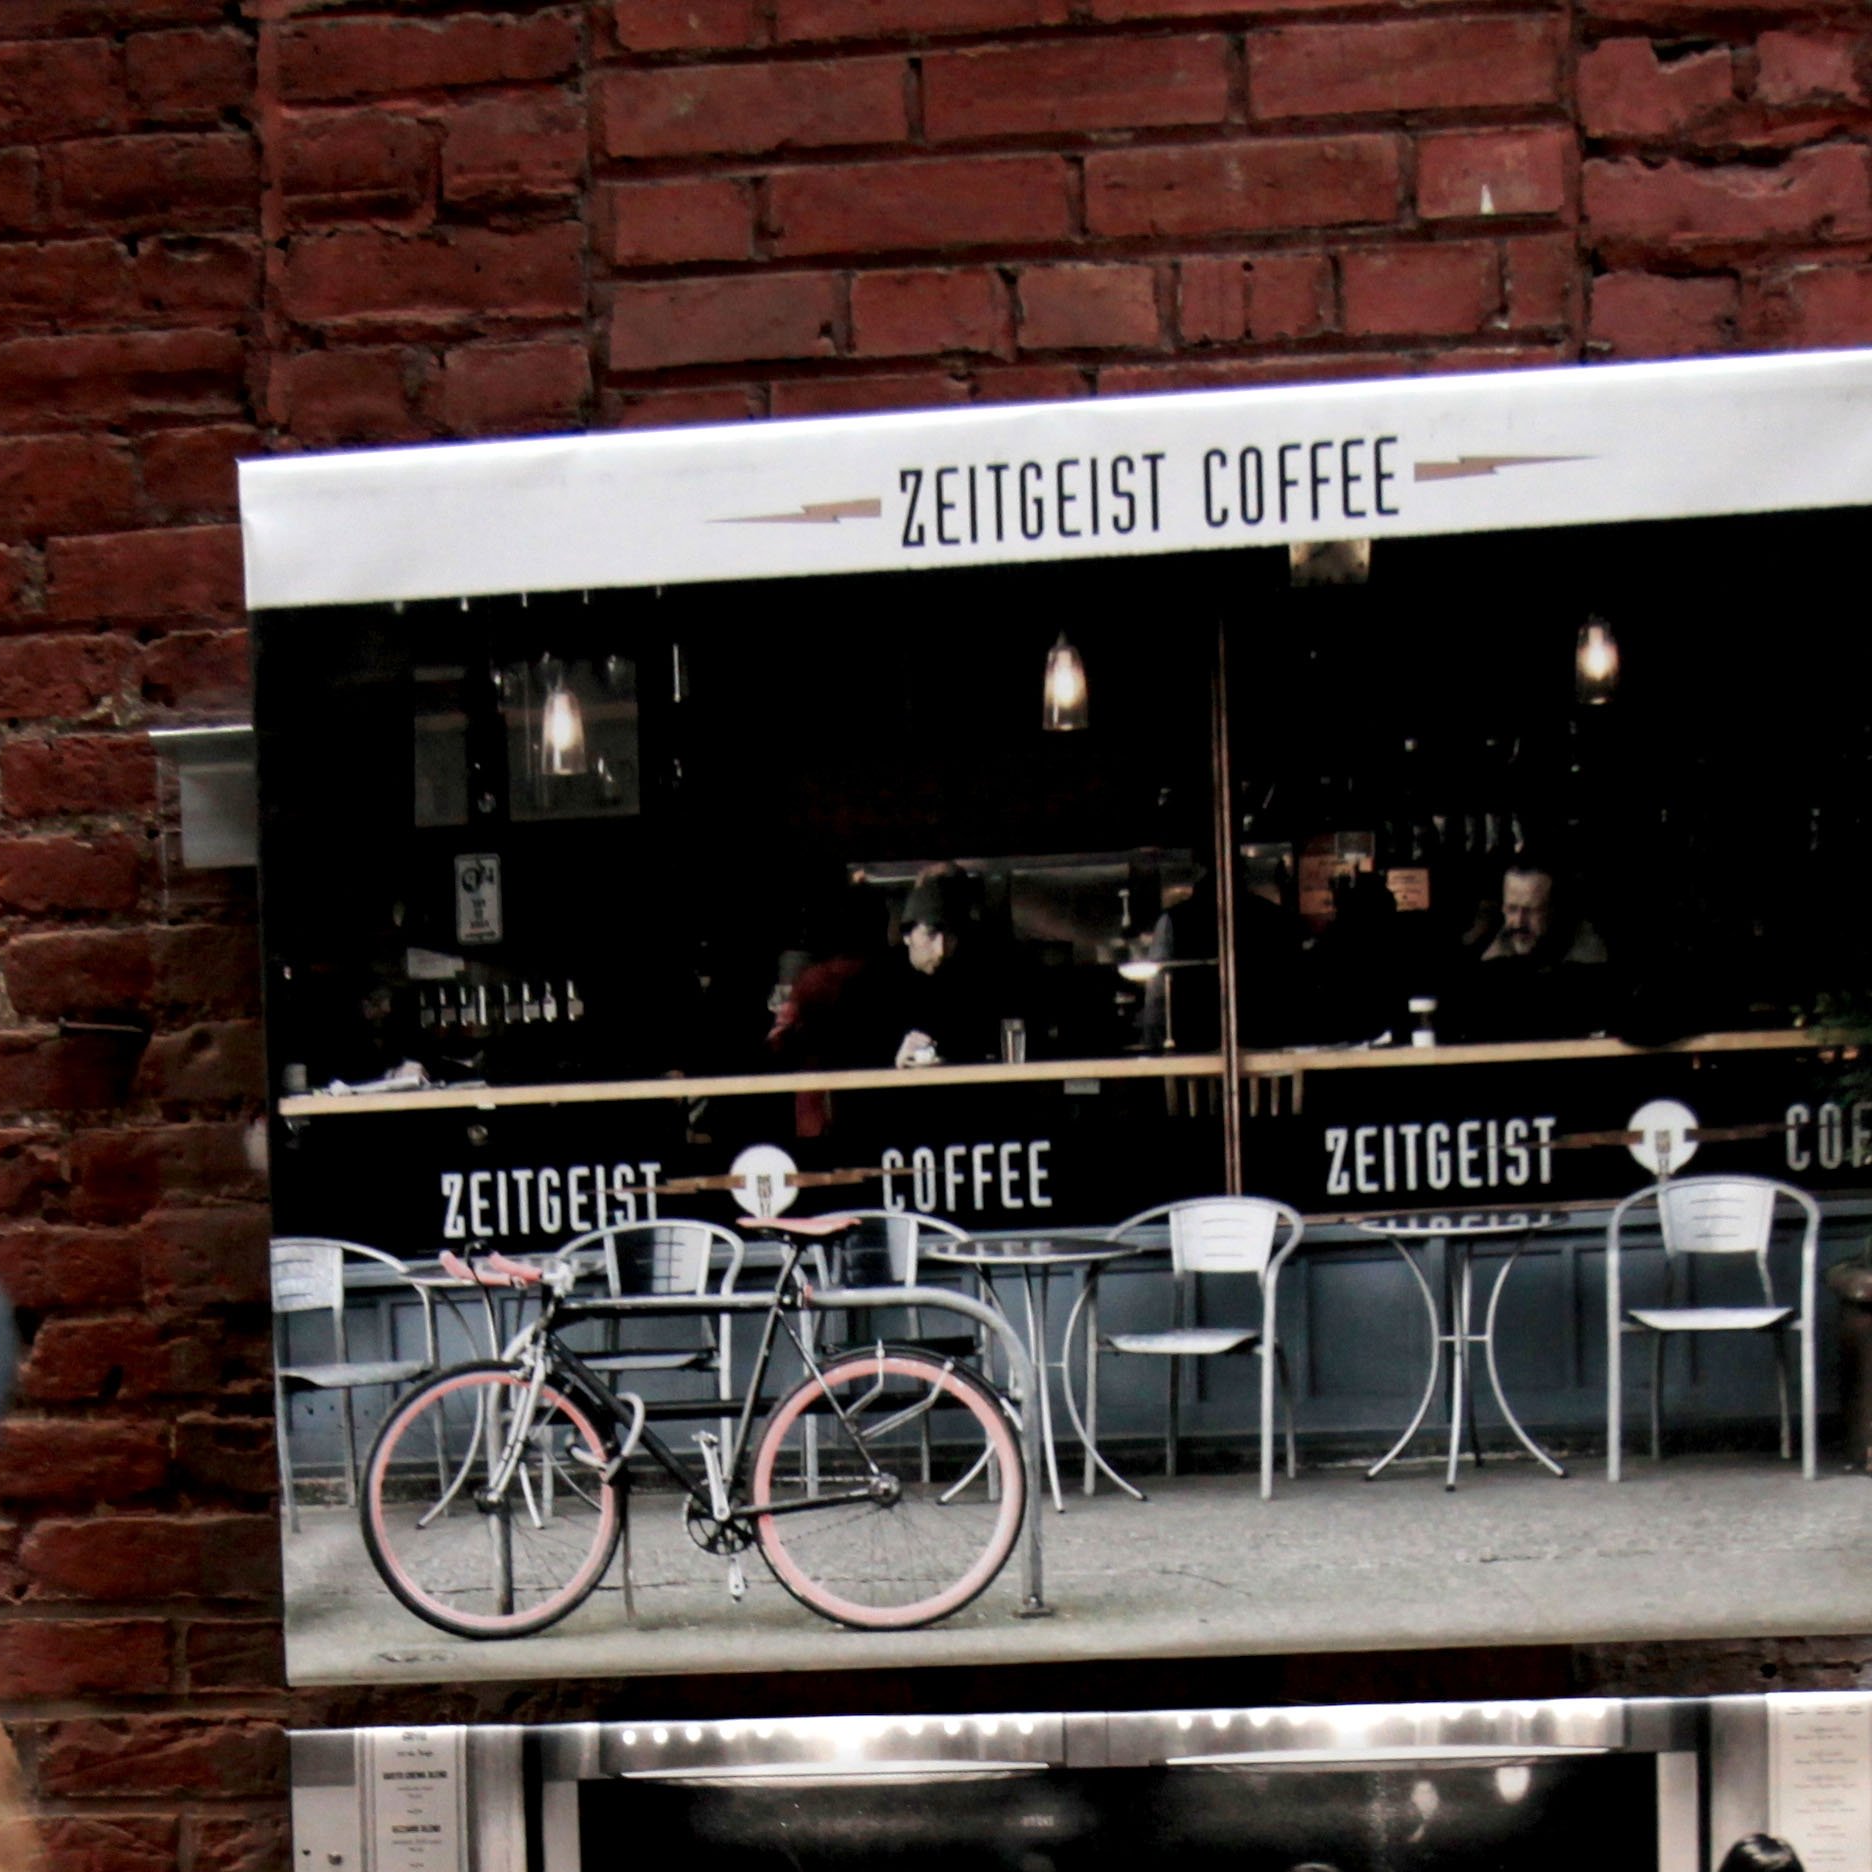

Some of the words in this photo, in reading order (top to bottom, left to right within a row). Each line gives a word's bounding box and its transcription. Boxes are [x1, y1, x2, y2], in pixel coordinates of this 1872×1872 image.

[899, 452, 1166, 549] ZEITGEIST
[1203, 436, 1400, 528] COFFEE
[441, 1162, 662, 1239] ZEITGEIST
[881, 1140, 1053, 1214] COFFEE
[1325, 1116, 1557, 1195] ZEITGEIST
